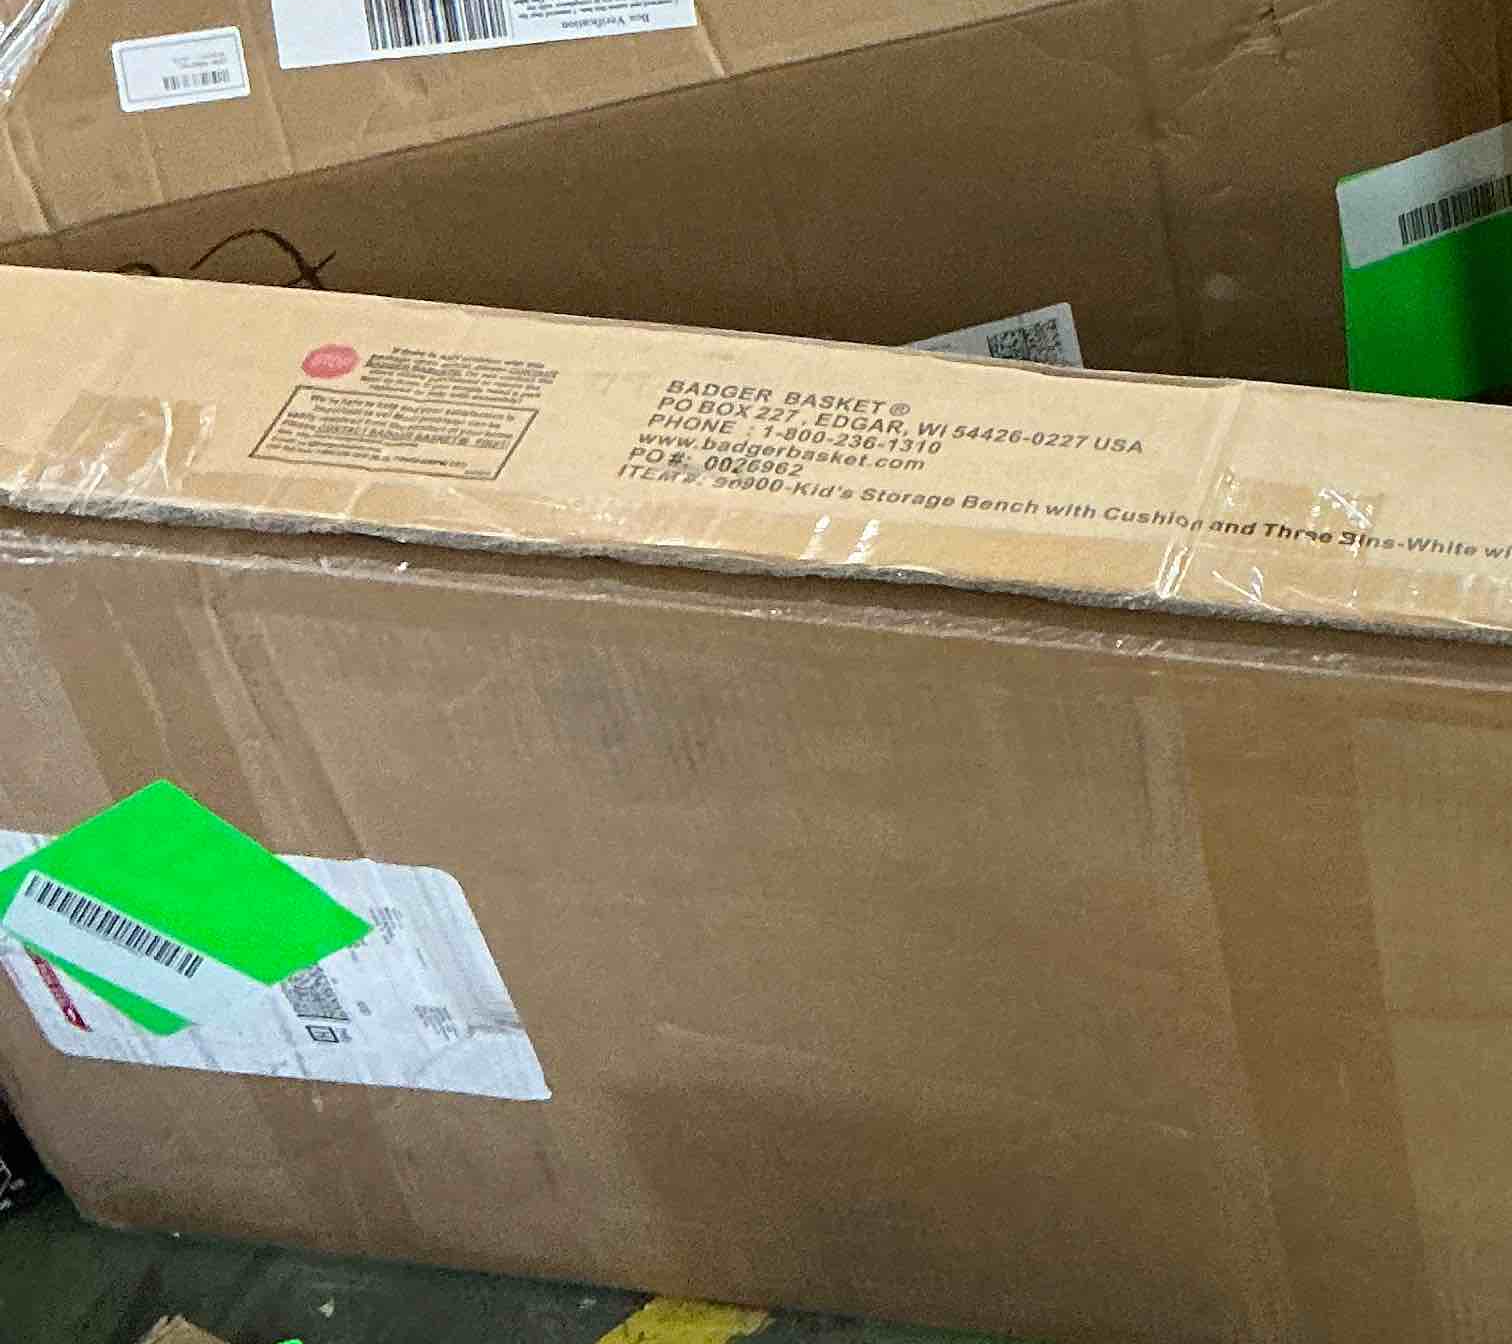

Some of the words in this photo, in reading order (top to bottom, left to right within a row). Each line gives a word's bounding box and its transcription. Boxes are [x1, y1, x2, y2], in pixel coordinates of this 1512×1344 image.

[666, 379, 773, 404] BADGER
[783, 391, 886, 416] BASKET
[647, 414, 738, 436] PHONE
[761, 424, 942, 455] 1-800-236-1310
[656, 396, 694, 413] PO
[698, 401, 751, 421] BOX
[813, 412, 908, 436] EDGAR,
[917, 421, 947, 439] WI
[951, 424, 1089, 450] 54426-0227
[1093, 436, 1144, 455] USA
[627, 446, 665, 464] PO
[702, 455, 804, 477] 0026962
[637, 432, 926, 471] www.badgerbasket.com
[859, 487, 956, 510] Storage
[961, 495, 1039, 515] Bench
[1045, 504, 1097, 521] with
[1103, 506, 1204, 533] Cushion
[1208, 520, 1258, 536] and
[1262, 522, 1334, 545] Three
